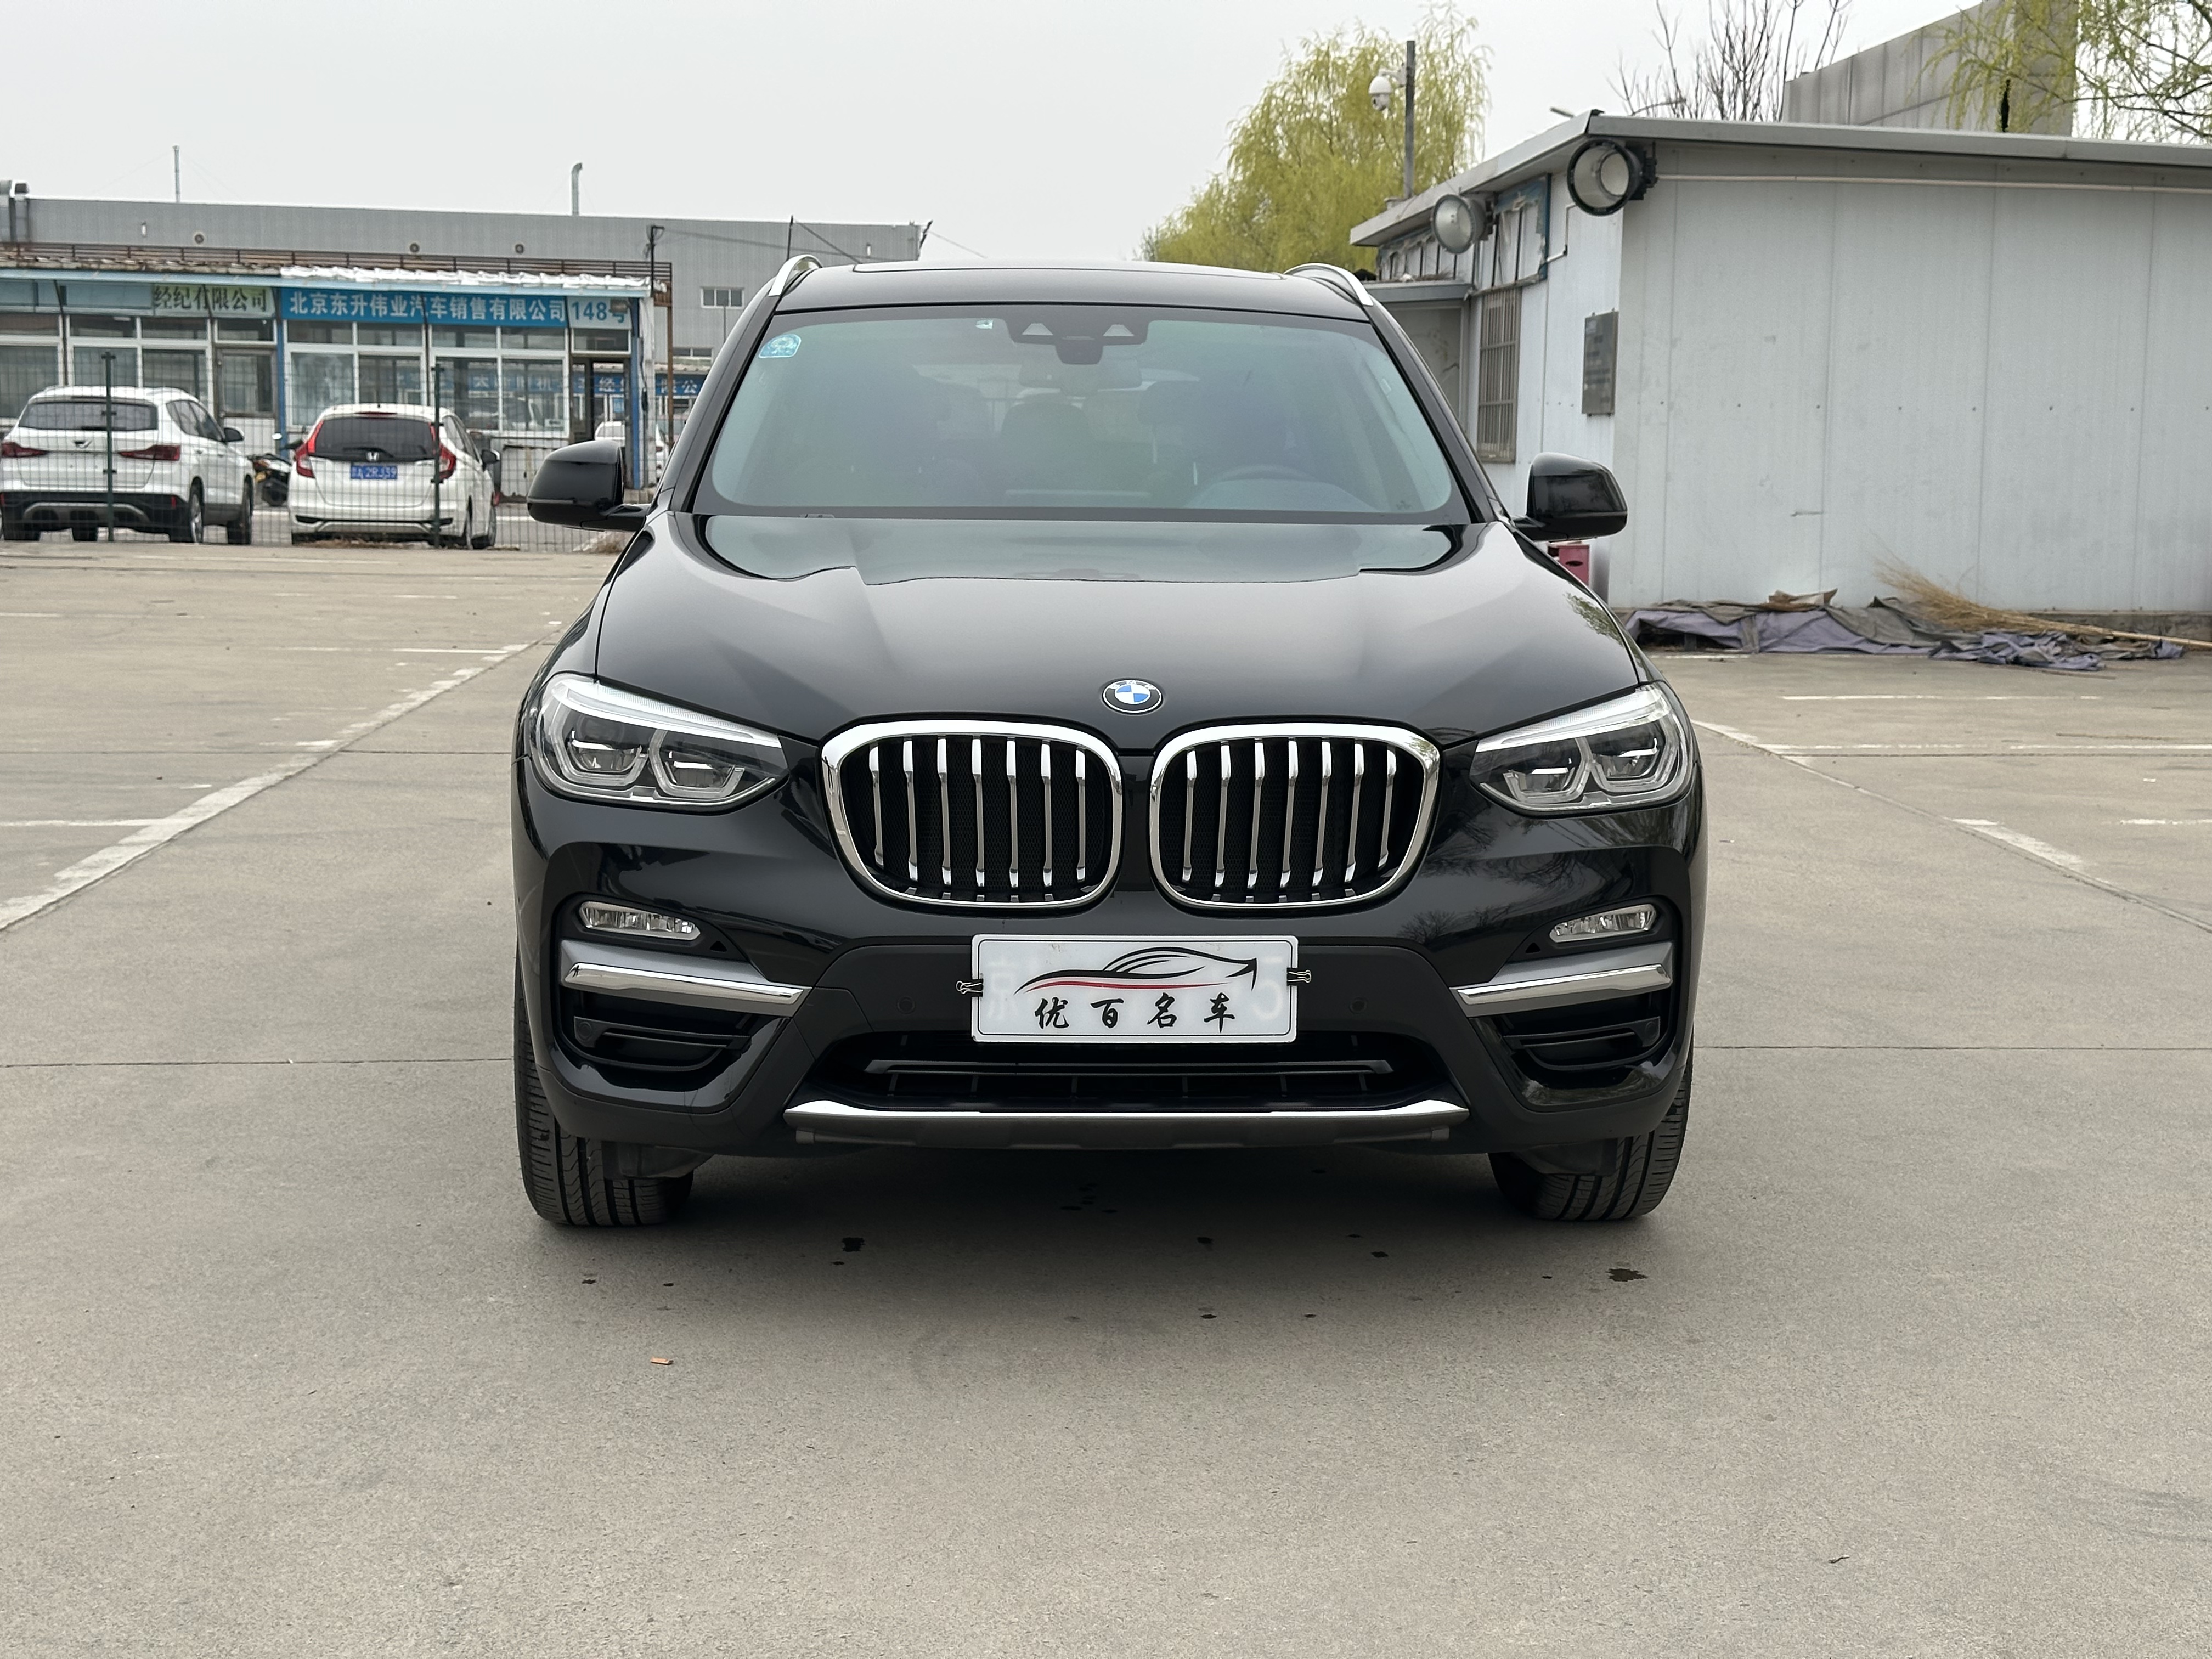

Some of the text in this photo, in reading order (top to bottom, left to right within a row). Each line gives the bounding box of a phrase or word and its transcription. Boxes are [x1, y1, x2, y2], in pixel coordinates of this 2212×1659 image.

[153, 285, 267, 312] 经纪有限公司
[289, 291, 566, 323] 北京东升伟业汽车销售有限公司
[1034, 992, 1235, 1033] 优百名车
